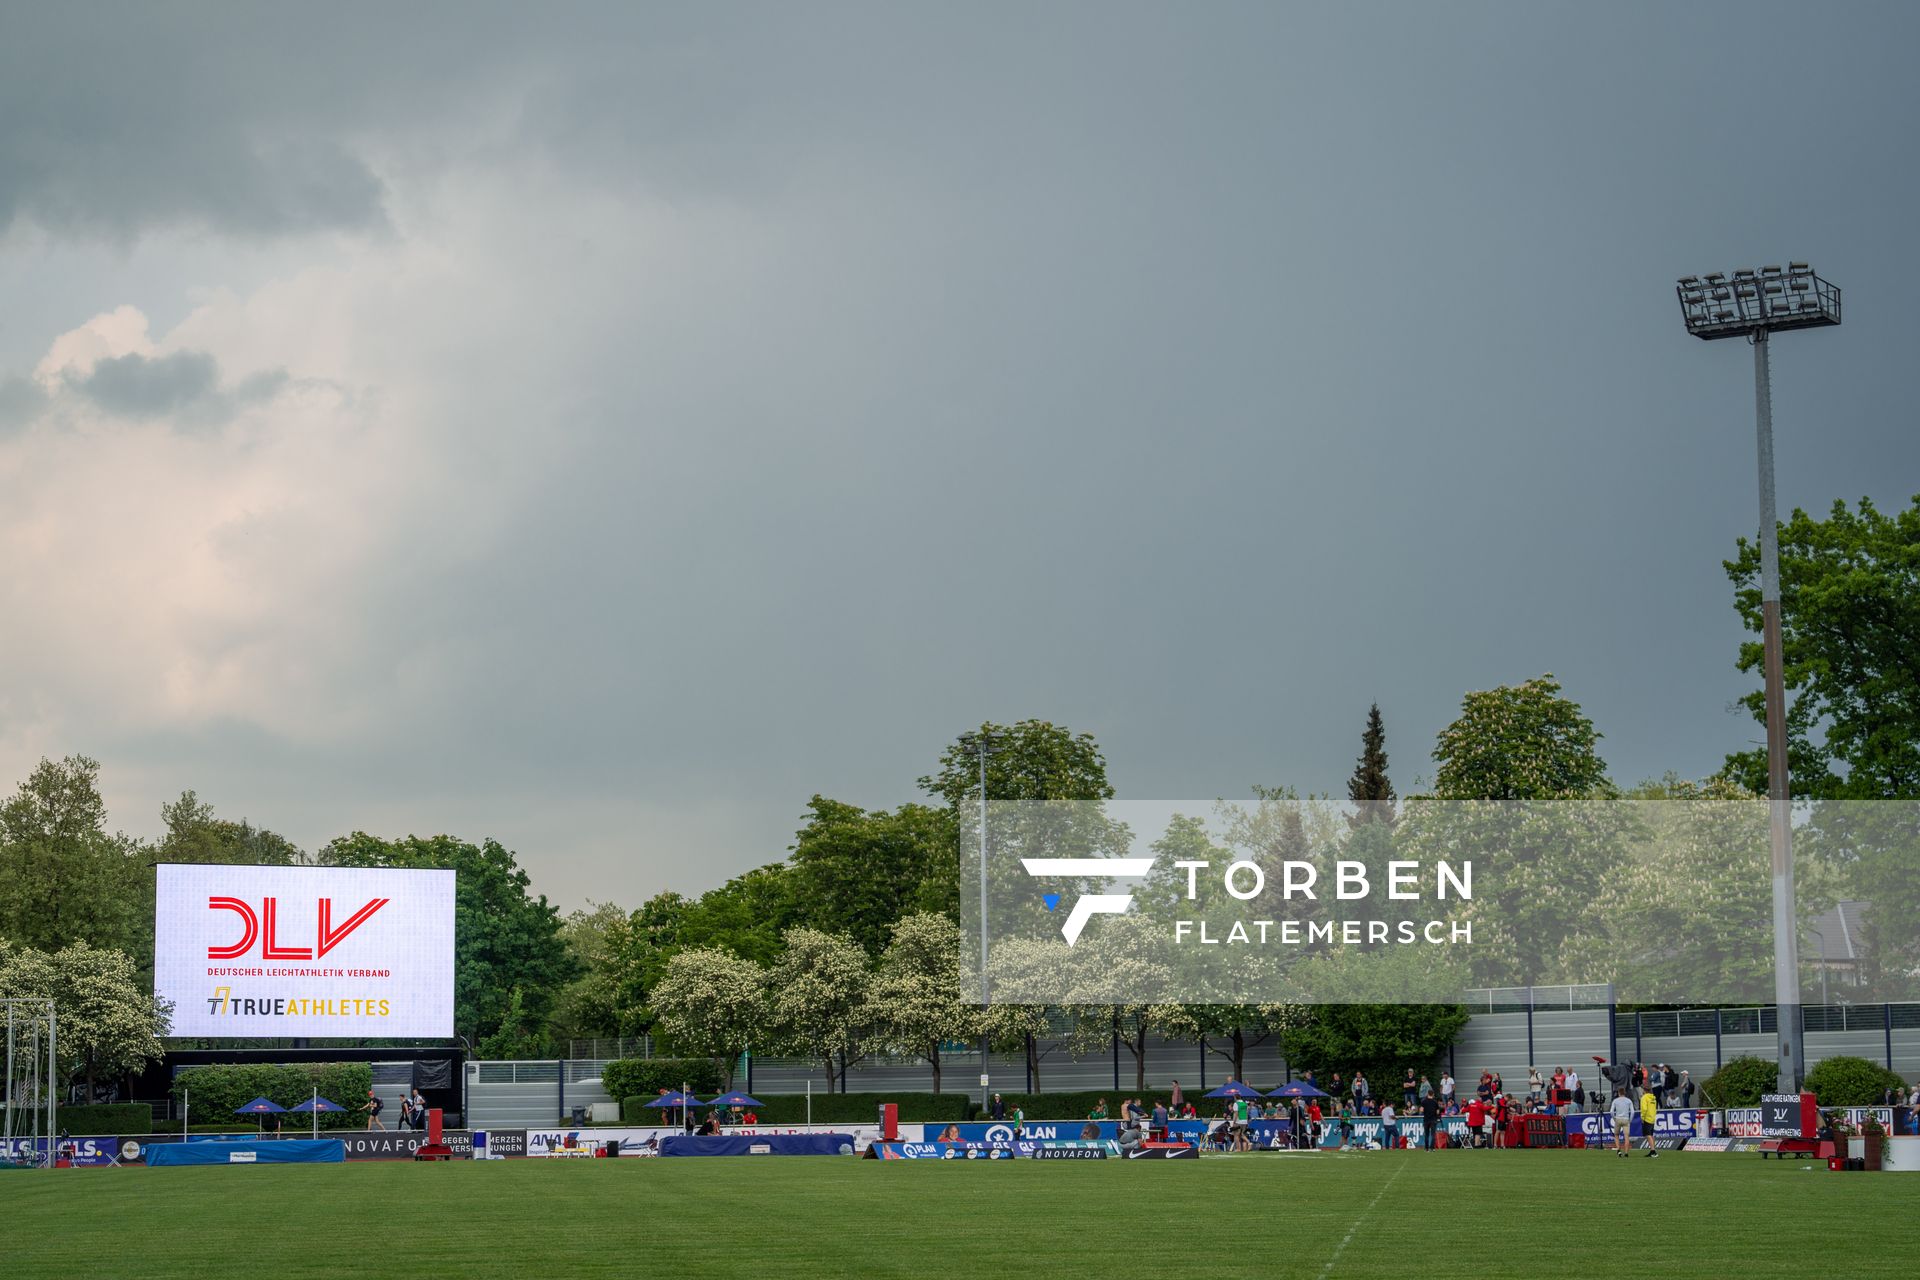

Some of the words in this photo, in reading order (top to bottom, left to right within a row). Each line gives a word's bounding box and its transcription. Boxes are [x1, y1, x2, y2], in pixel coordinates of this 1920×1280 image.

[208, 896, 391, 960] DLV
[207, 967, 263, 977] DEUTSCHER
[266, 968, 344, 977] LEICHTATHLETIK
[347, 969, 391, 978] VERBAND
[230, 998, 390, 1016] TRUEATHLETES
[1728, 1124, 1744, 1135] MOLY
[916, 1145, 936, 1153] PLAN
[1045, 1150, 1100, 1158] NOVAFON
